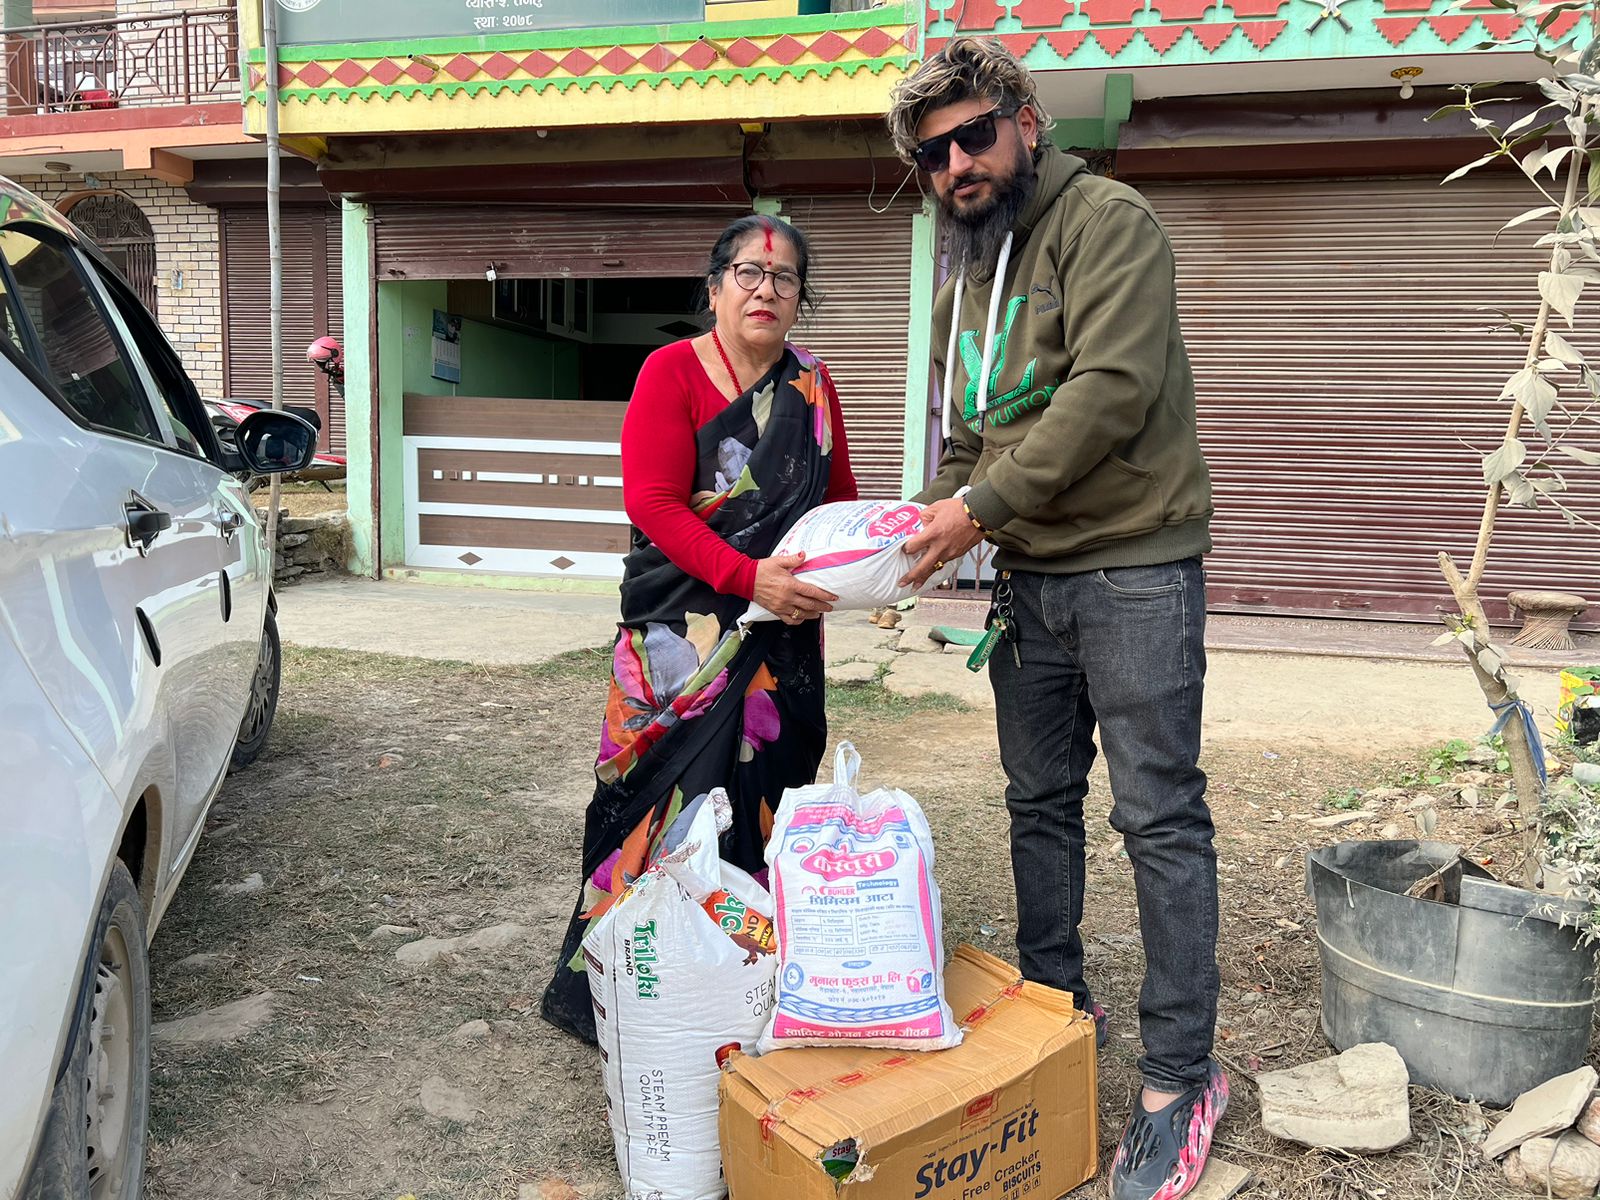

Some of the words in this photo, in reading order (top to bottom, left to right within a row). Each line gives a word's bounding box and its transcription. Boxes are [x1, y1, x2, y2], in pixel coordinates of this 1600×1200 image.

[502, 14, 533, 27] २०७८
[864, 893, 894, 903] आटा
[624, 938, 634, 977] BRAND
[633, 919, 661, 1000] Triloki
[898, 1026, 930, 1037] जीवन
[639, 1074, 654, 1129] QUALITY
[652, 1069, 666, 1112] STEAM
[914, 1107, 1040, 1199] Stay-Fit
[962, 1181, 991, 1200] Free
[993, 1149, 1041, 1182] Cracker
[1002, 1161, 1042, 1193] BISCUITS
